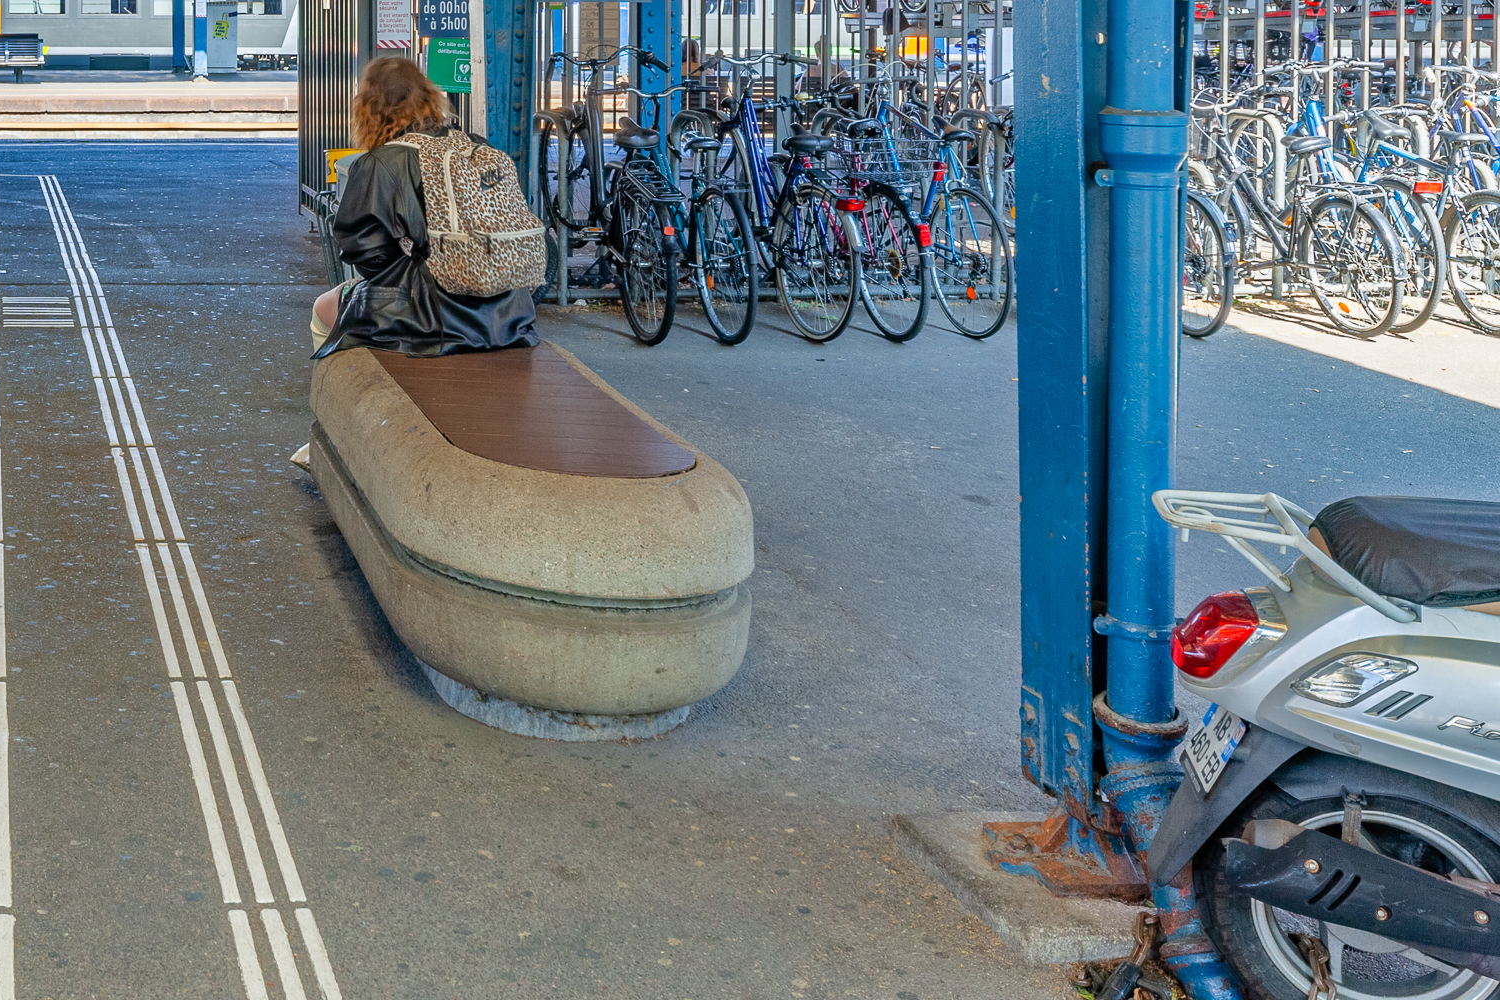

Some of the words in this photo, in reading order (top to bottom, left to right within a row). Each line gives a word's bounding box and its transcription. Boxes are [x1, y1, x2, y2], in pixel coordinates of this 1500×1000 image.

[424, 0, 436, 14] de
[430, 17, 436, 30] à
[440, 17, 467, 31] 5h00
